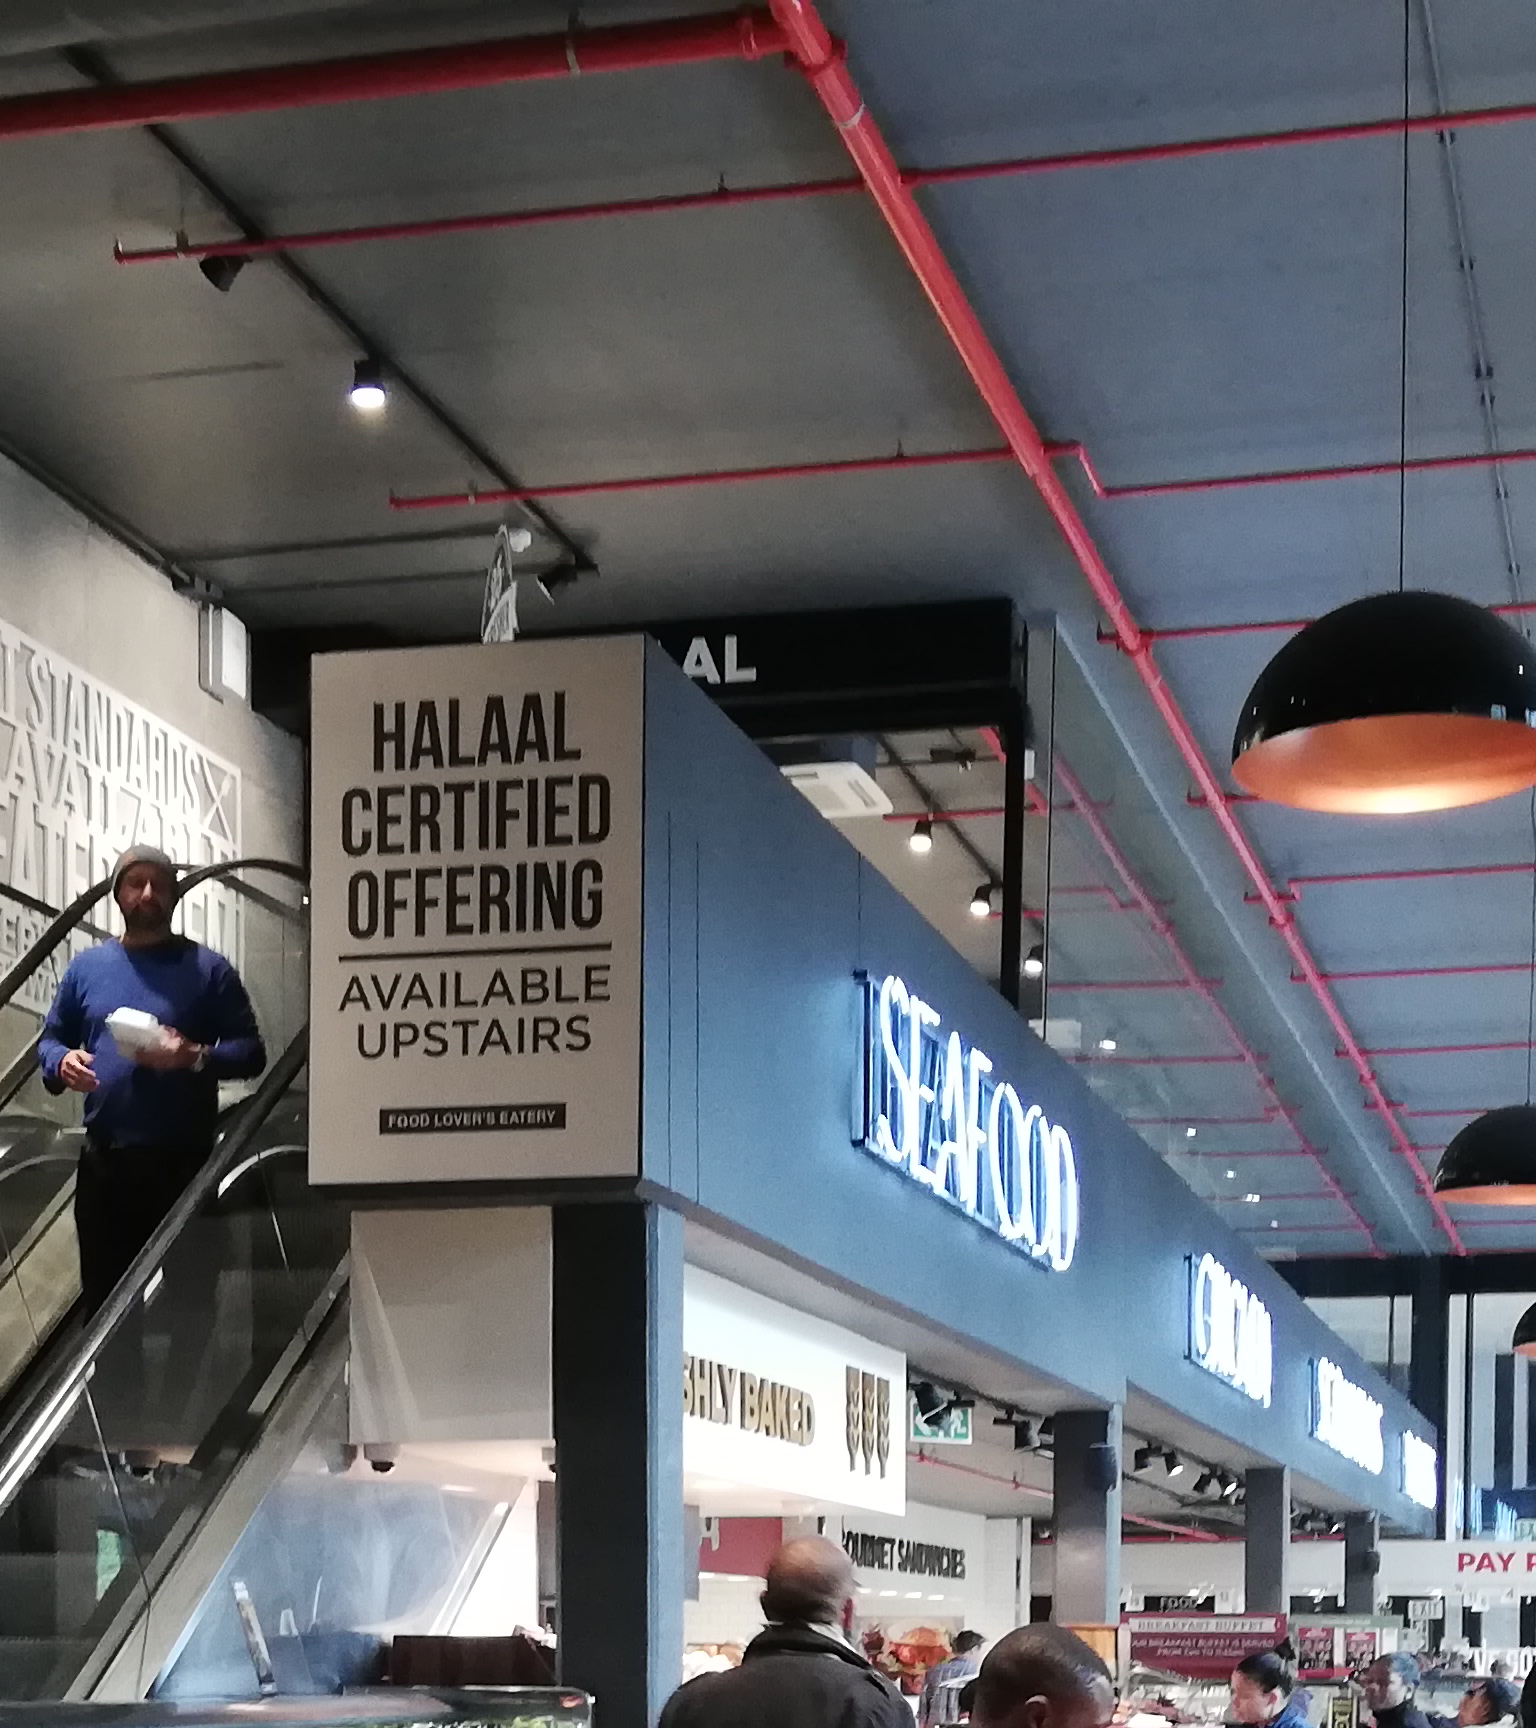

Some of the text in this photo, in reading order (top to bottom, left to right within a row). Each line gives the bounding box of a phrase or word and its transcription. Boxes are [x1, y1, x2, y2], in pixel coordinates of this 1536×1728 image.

[372, 691, 582, 772] HALAAL
[340, 773, 611, 857] CERTIFIED
[347, 858, 604, 941] OFFERING
[338, 964, 611, 1012] AVAILABLE
[357, 1014, 593, 1060] UPSTAIRS
[388, 1113, 430, 1129] FOOD
[499, 1109, 556, 1125] EATERY
[879, 975, 1079, 1272] SEAFOOD
[683, 1351, 815, 1447] SHLY BAKED
[842, 1530, 896, 1571] OURMET
[1457, 1552, 1516, 1573] PAY
